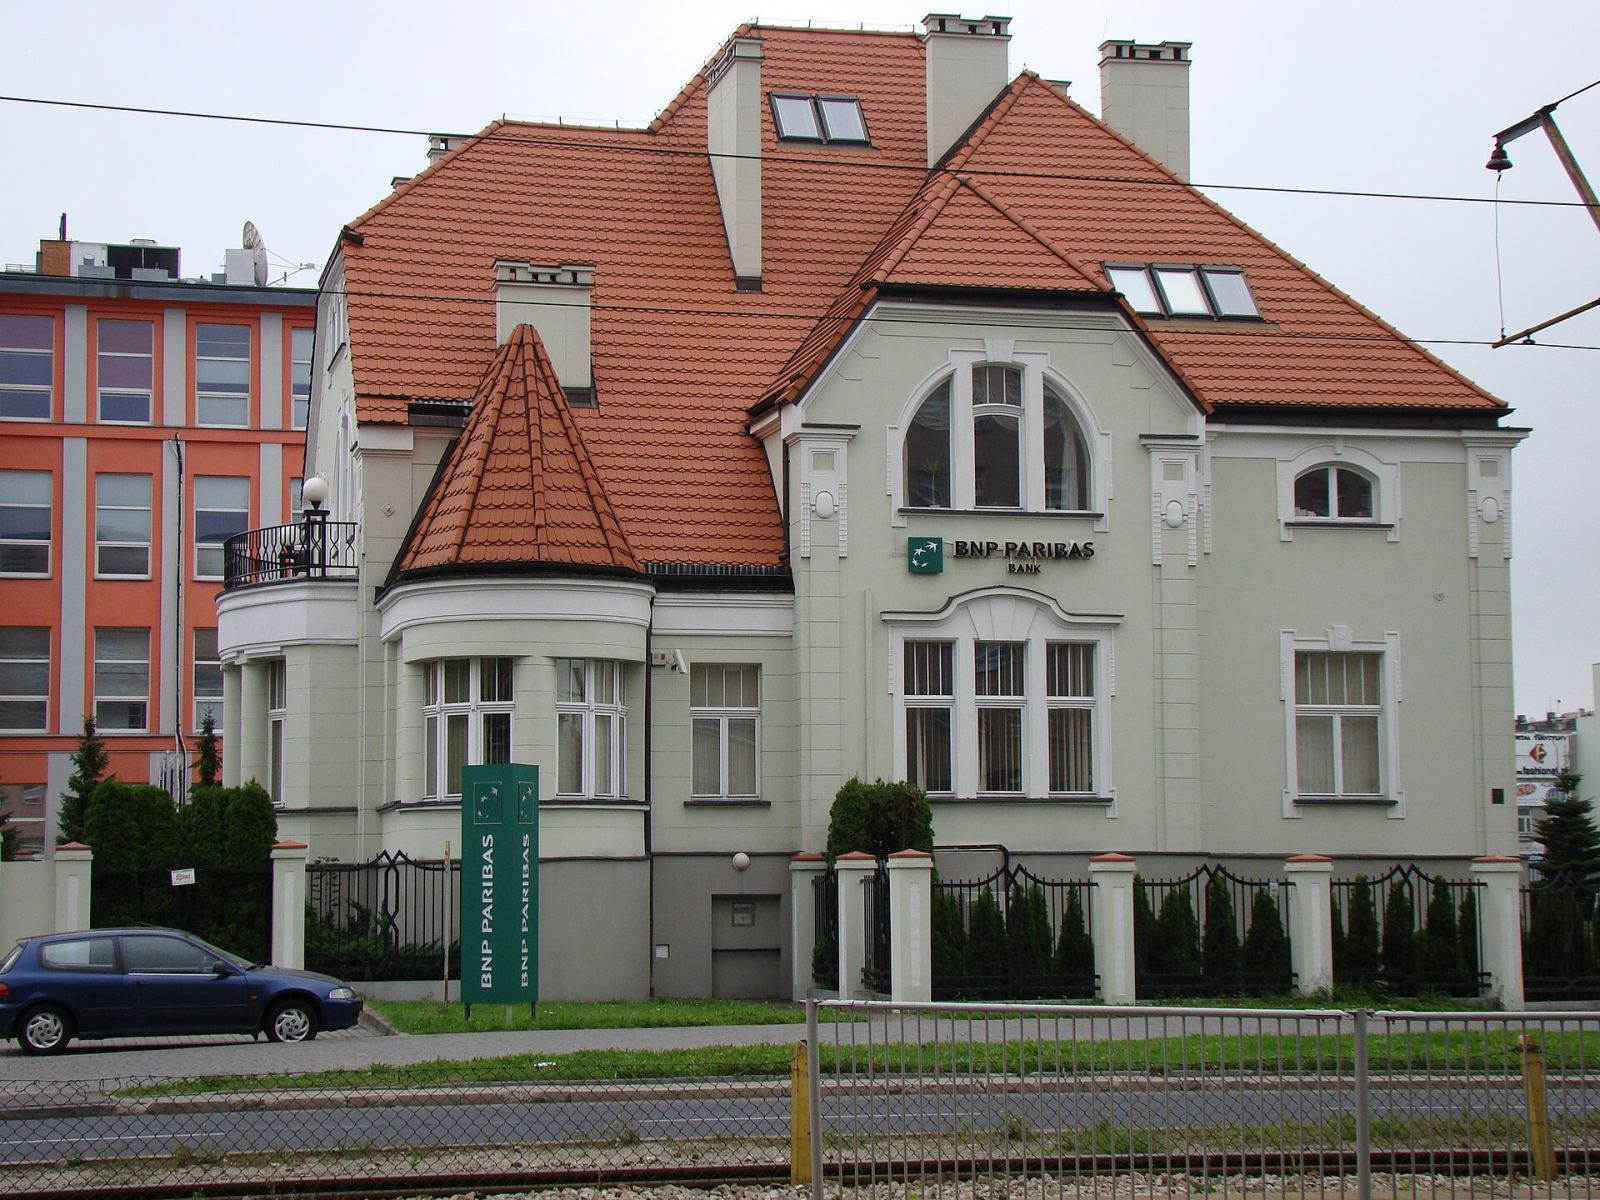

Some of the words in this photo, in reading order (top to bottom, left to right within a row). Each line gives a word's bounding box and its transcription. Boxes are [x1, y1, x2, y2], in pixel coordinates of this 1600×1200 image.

[954, 540, 999, 557] BNP
[1004, 541, 1095, 558] PARIBAS
[1008, 563, 1041, 574] BANK
[482, 834, 493, 933] PARIBAS
[522, 834, 530, 932] PARIBAS
[481, 939, 492, 988] BNP
